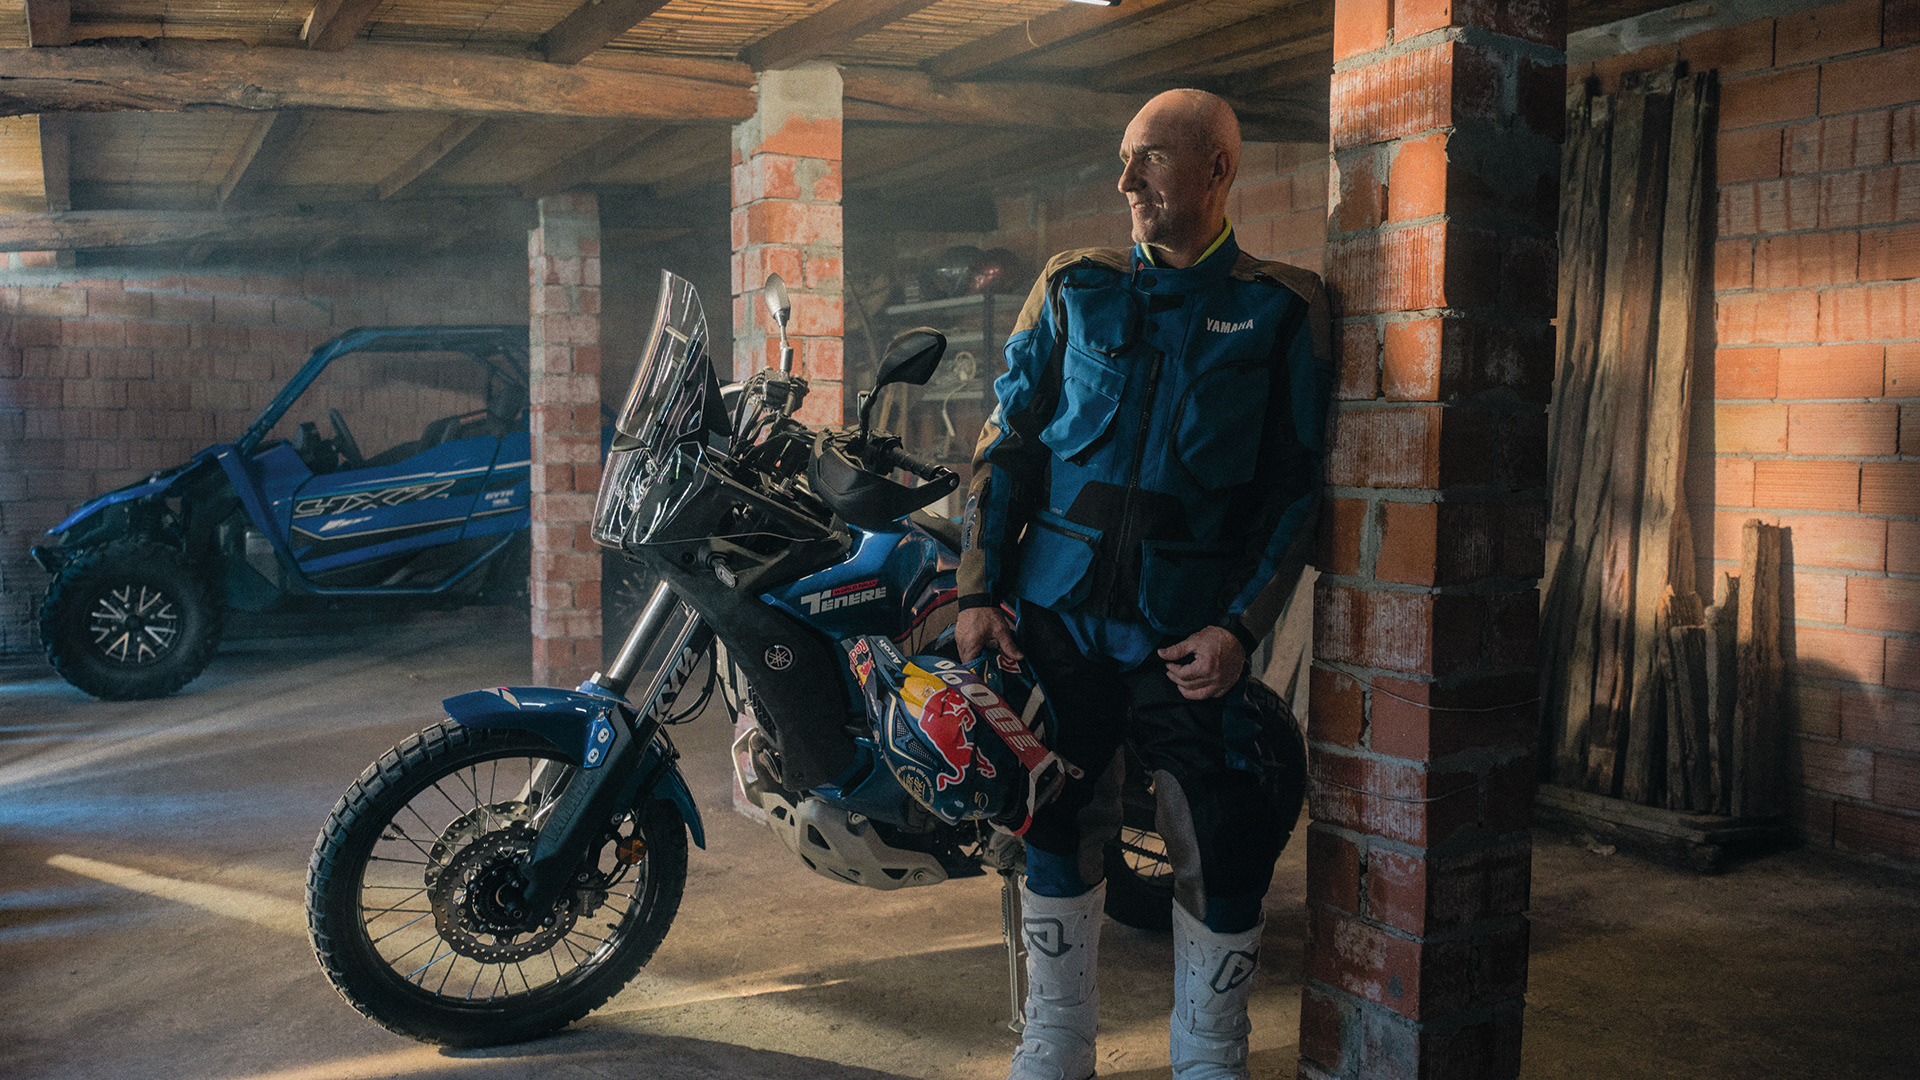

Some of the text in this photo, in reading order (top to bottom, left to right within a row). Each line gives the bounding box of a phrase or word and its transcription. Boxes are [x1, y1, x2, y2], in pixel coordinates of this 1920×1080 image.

[1206, 317, 1254, 334] YAMAHA
[849, 637, 870, 666] Red
[879, 639, 902, 664] Airoh
[647, 646, 699, 725] KYB
